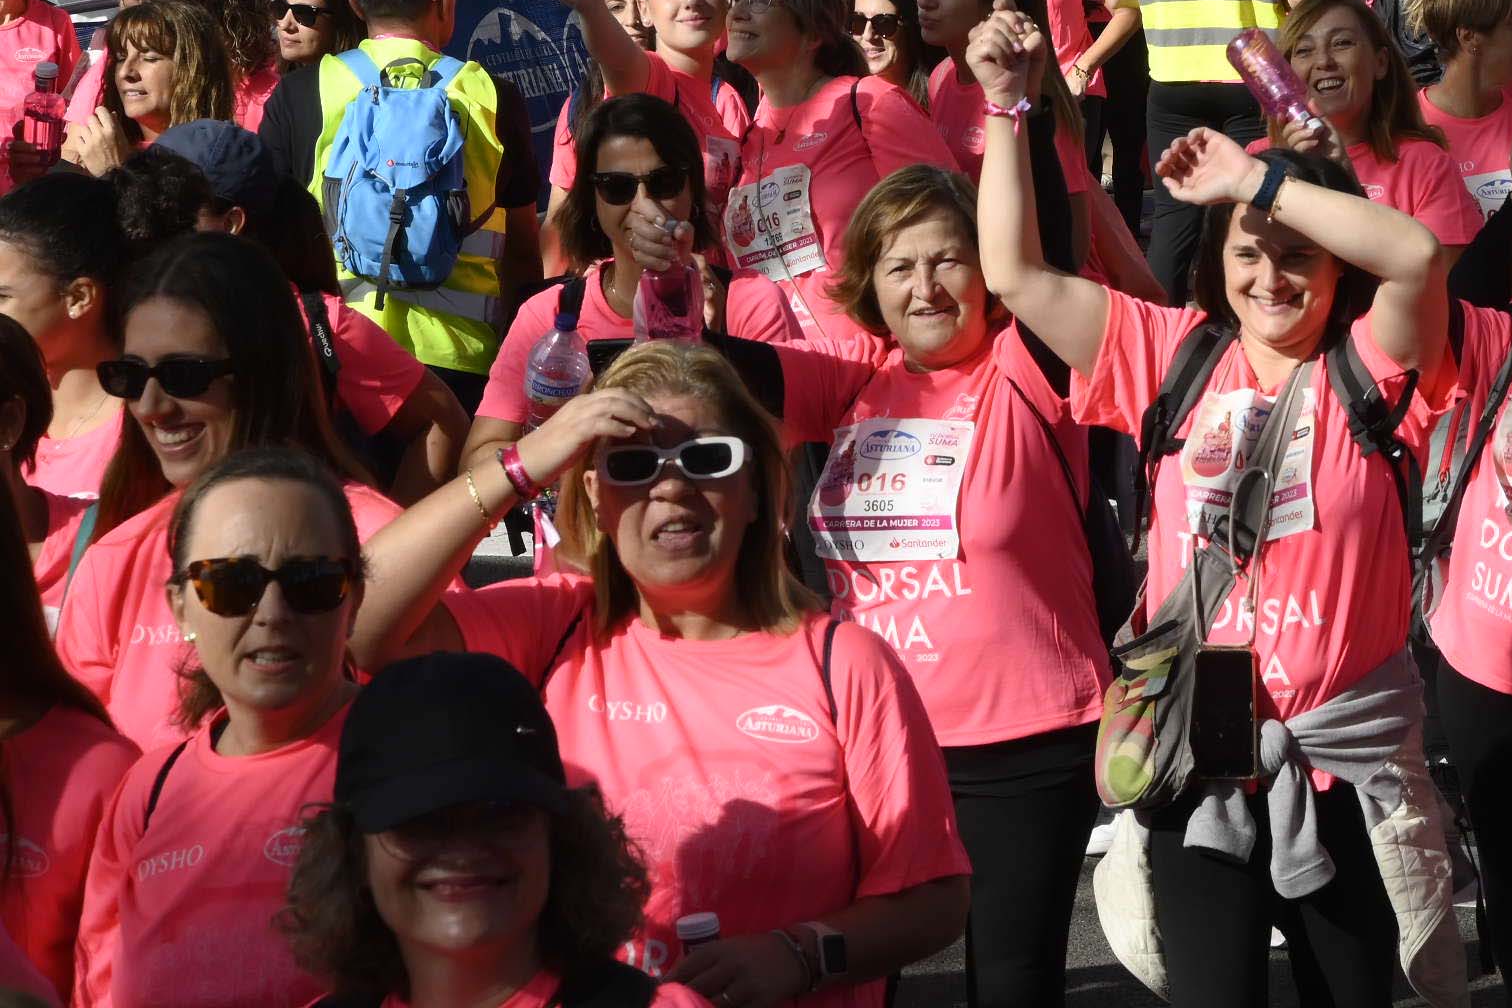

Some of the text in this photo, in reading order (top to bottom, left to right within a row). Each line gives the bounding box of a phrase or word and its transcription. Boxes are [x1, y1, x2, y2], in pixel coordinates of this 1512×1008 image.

[928, 438, 958, 447] SUMA
[857, 473, 907, 492] 016
[864, 500, 894, 512] 3605
[823, 520, 862, 528] CARRERA
[864, 520, 875, 528] DE
[892, 519, 918, 527] MUJER
[921, 519, 941, 527] 2023
[901, 539, 946, 548] Santander
[827, 562, 972, 602] DORSAL
[1212, 588, 1327, 635] ORSAL
[133, 624, 184, 645] OYSH
[588, 695, 667, 724] OYSHO
[743, 716, 814, 739] ASTURIANA
[138, 844, 205, 882] OYSHO
